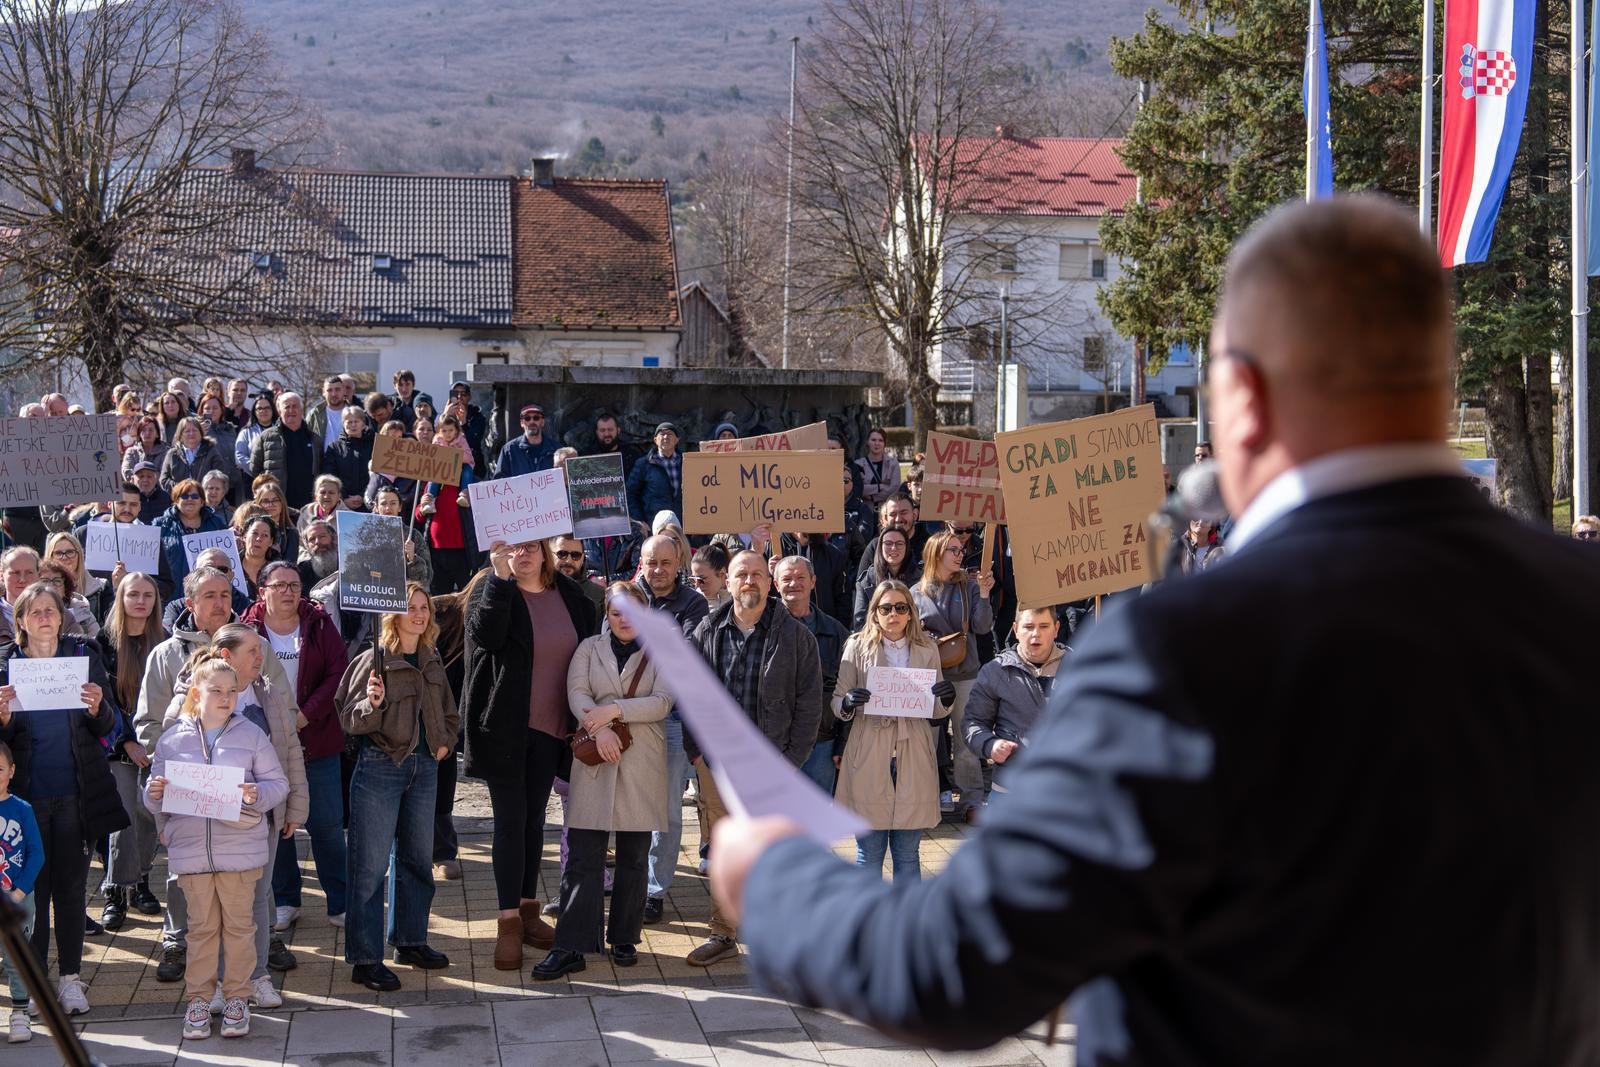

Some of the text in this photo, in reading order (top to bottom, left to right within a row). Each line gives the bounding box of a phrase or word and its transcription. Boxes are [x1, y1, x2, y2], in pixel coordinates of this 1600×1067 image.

[62, 432, 113, 452] IZAZOVE
[391, 439, 437, 458] NE DAMO
[931, 438, 1000, 468] VALjD
[1006, 419, 1157, 474] GRADI STANOVE
[22, 454, 80, 477] RAČUN
[381, 449, 460, 482] ŽELJAVU!
[701, 463, 811, 494] od MIGova
[955, 467, 982, 488] MI
[1029, 474, 1058, 500] ZA
[1075, 456, 1138, 489] MLADE
[51, 471, 120, 497] SREDINA!
[475, 474, 555, 501] LIKA NIJE
[500, 494, 539, 513] NIČIJI
[700, 496, 825, 523] do MIGranata
[936, 490, 1006, 521] PITA
[1068, 495, 1103, 531] NE
[485, 507, 570, 538] EKSPERIMENT
[187, 536, 233, 554] GLUPO
[1032, 522, 1146, 565] KAMPOVE ZA
[1056, 550, 1142, 588] MIGRANTE
[343, 595, 407, 609] BEZ NARODA!!!
[350, 583, 397, 595] NE ODLUCI
